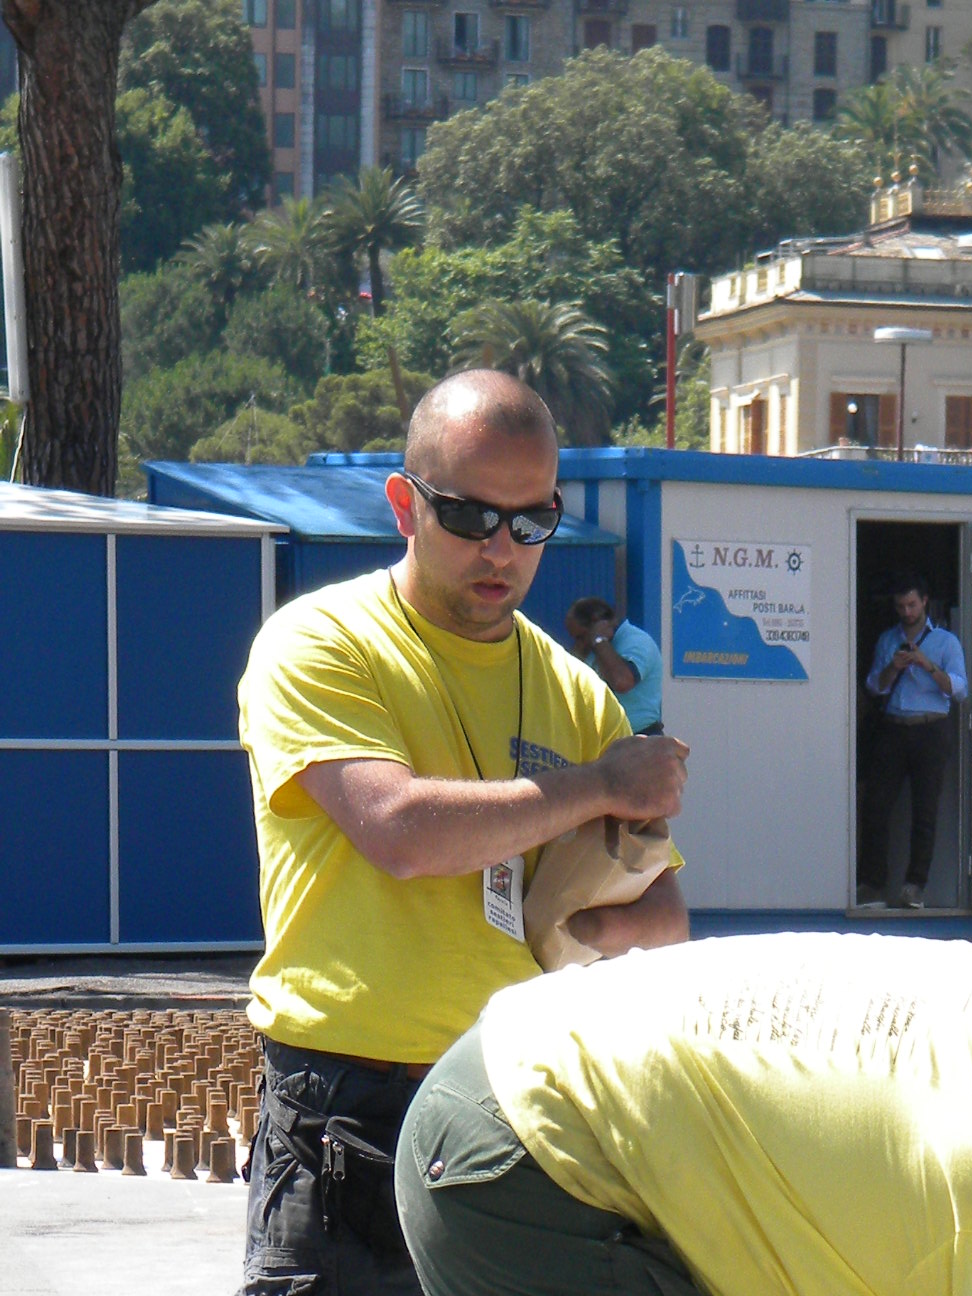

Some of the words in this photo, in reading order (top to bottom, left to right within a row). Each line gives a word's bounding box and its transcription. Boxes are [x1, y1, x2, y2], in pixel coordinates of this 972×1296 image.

[712, 547, 778, 569] N.G.M.
[728, 589, 767, 600] AFFITTASI
[753, 602, 776, 613] POSTI
[488, 901, 516, 922] comitato
[490, 909, 515, 928] sestieri
[488, 915, 517, 936] rapallesi
